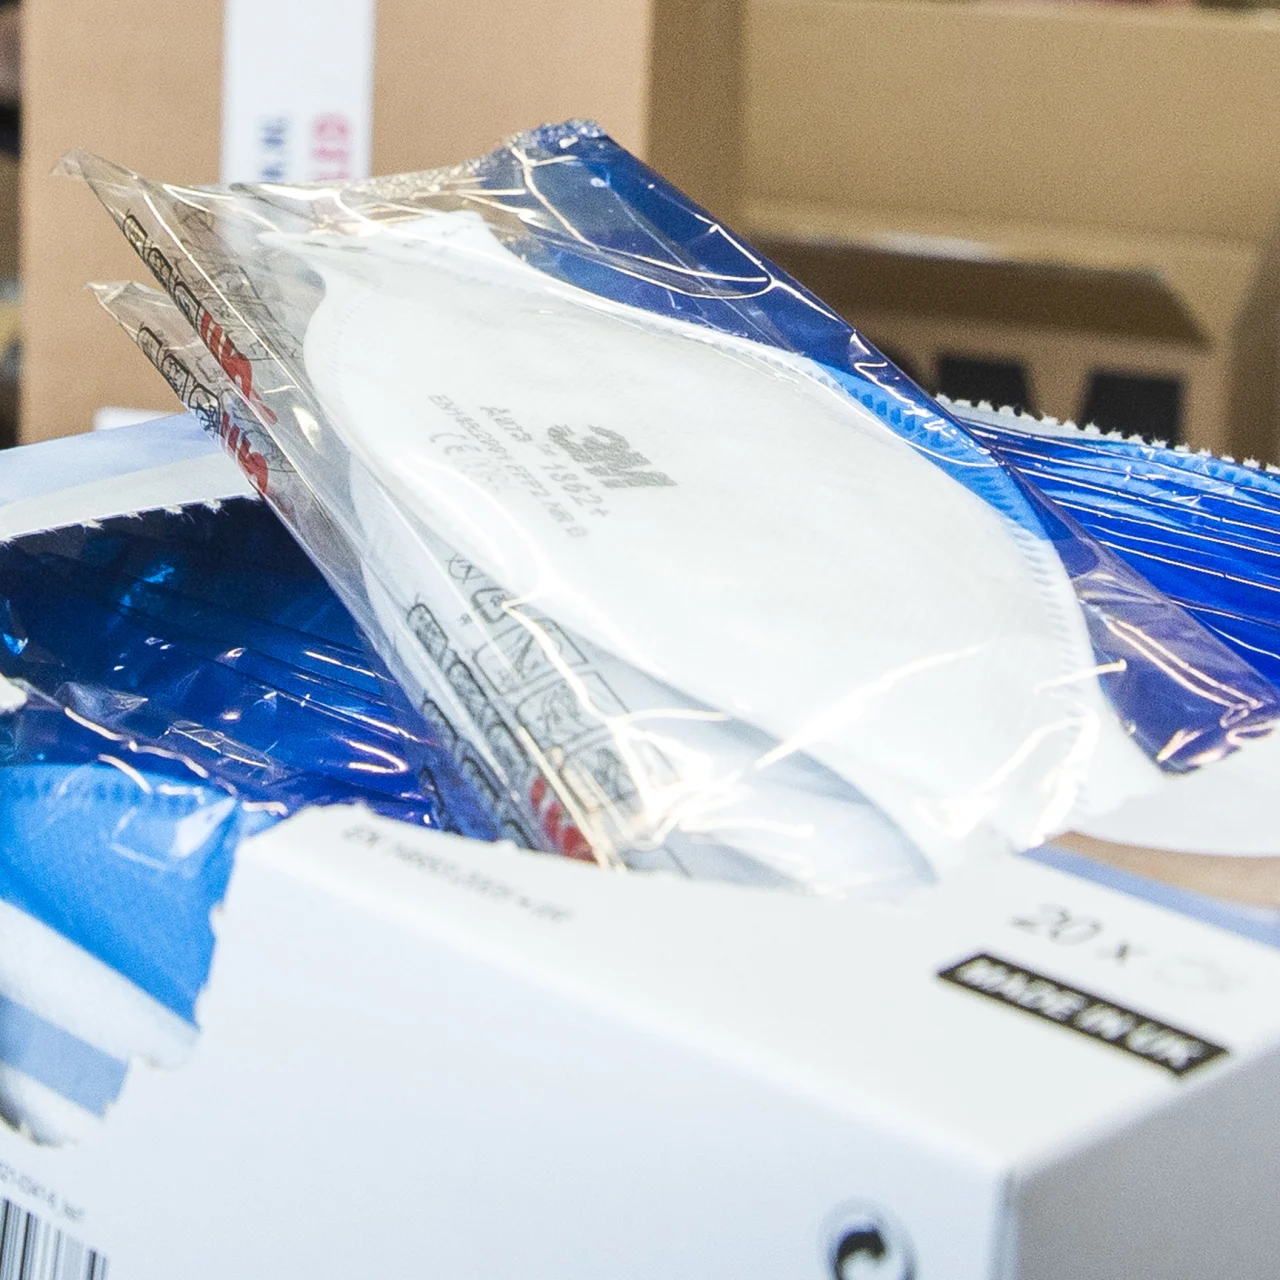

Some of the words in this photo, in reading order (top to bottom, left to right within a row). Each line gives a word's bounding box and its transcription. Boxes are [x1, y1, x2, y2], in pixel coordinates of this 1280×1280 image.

[547, 424, 678, 489] 3M
[952, 956, 1090, 1022] MADE
[1074, 1000, 1140, 1043] IN
[1124, 1020, 1208, 1070] UK
